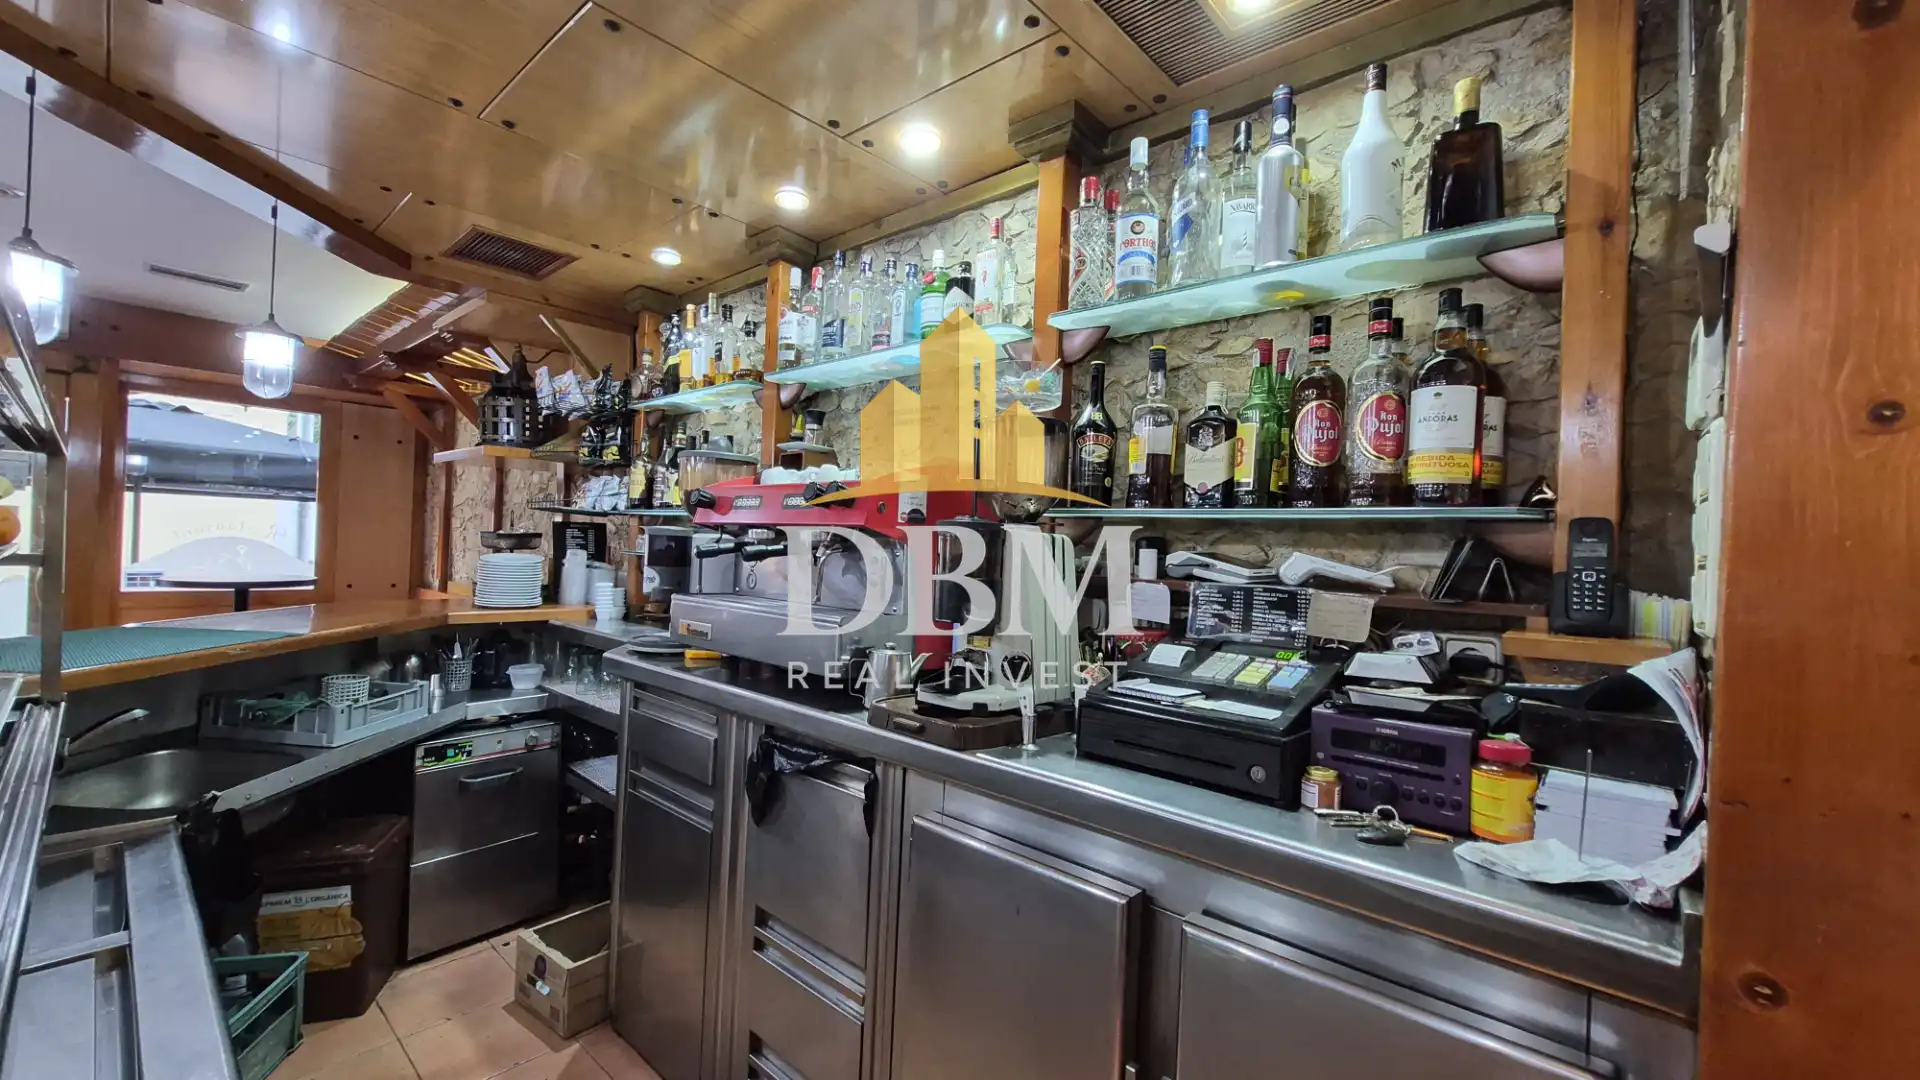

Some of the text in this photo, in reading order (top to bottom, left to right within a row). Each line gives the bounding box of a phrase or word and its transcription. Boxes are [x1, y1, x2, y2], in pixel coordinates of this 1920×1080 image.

[1380, 410, 1398, 420] Ron
[1364, 414, 1404, 437] Pujol
[1078, 434, 1113, 446] BAILEYS
